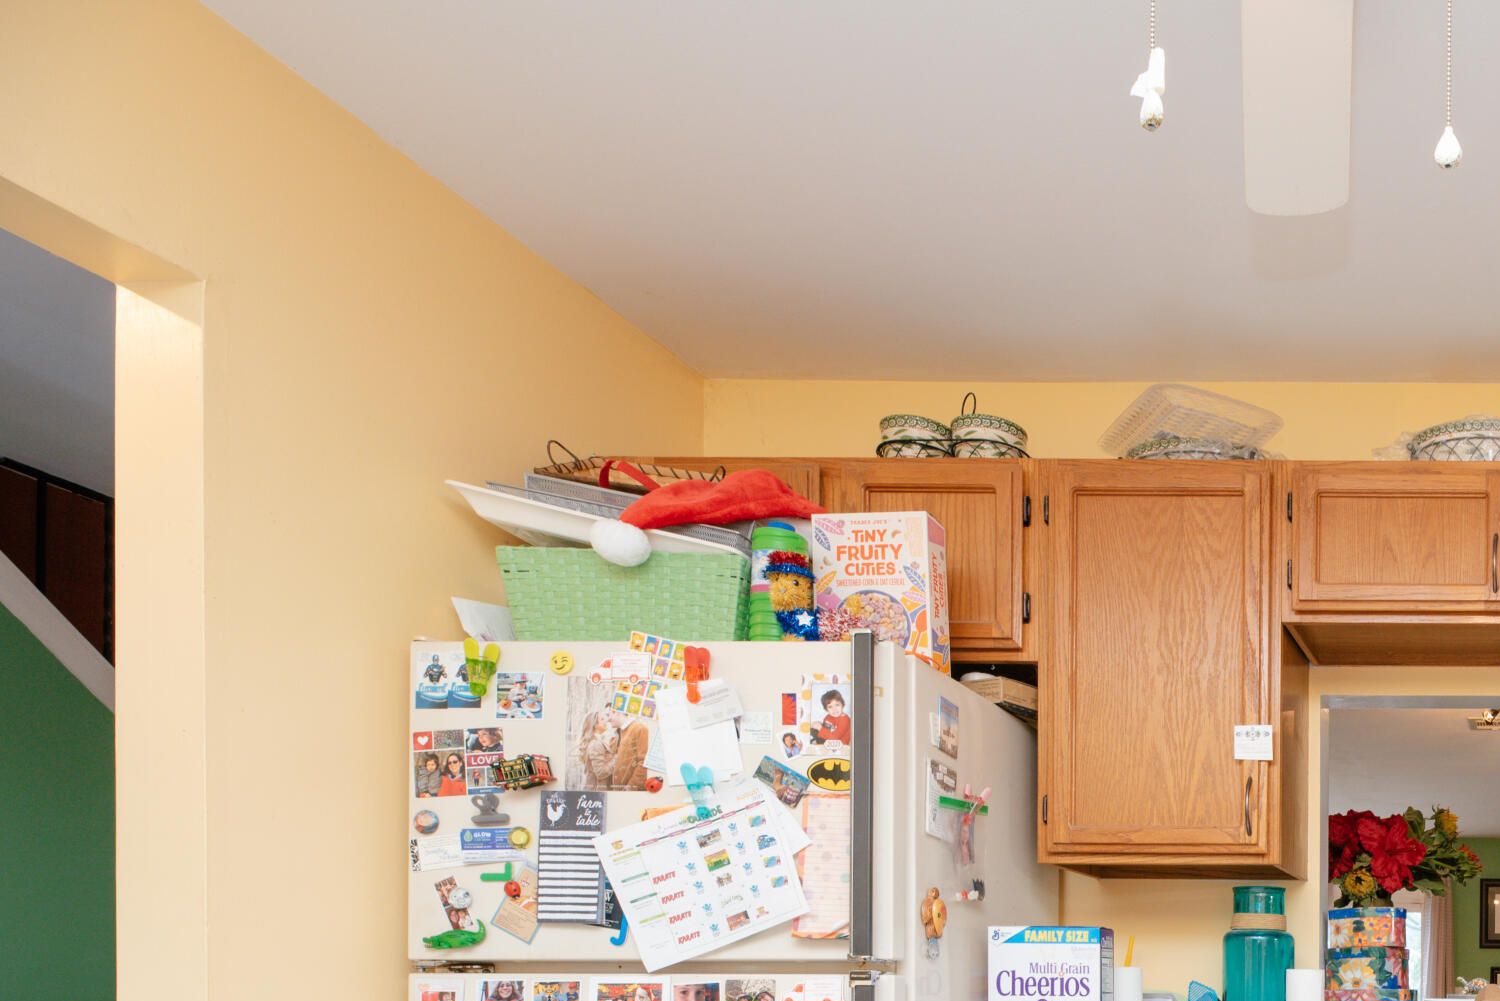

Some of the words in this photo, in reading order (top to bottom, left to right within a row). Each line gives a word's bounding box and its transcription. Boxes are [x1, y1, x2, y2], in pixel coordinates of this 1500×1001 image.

[471, 755, 499, 766] LOVE
[576, 794, 603, 810] farm
[576, 814, 601, 826] table
[652, 870, 676, 885] KARATE
[661, 890, 684, 905] KARATE
[669, 910, 692, 925] KARATE
[678, 931, 700, 945] KARATE
[1024, 929, 1064, 942] FAMILY
[1065, 930, 1089, 942] SIZE
[1029, 961, 1057, 974] Multi
[1060, 962, 1090, 974] Grain
[996, 969, 1090, 997] Cheerios
